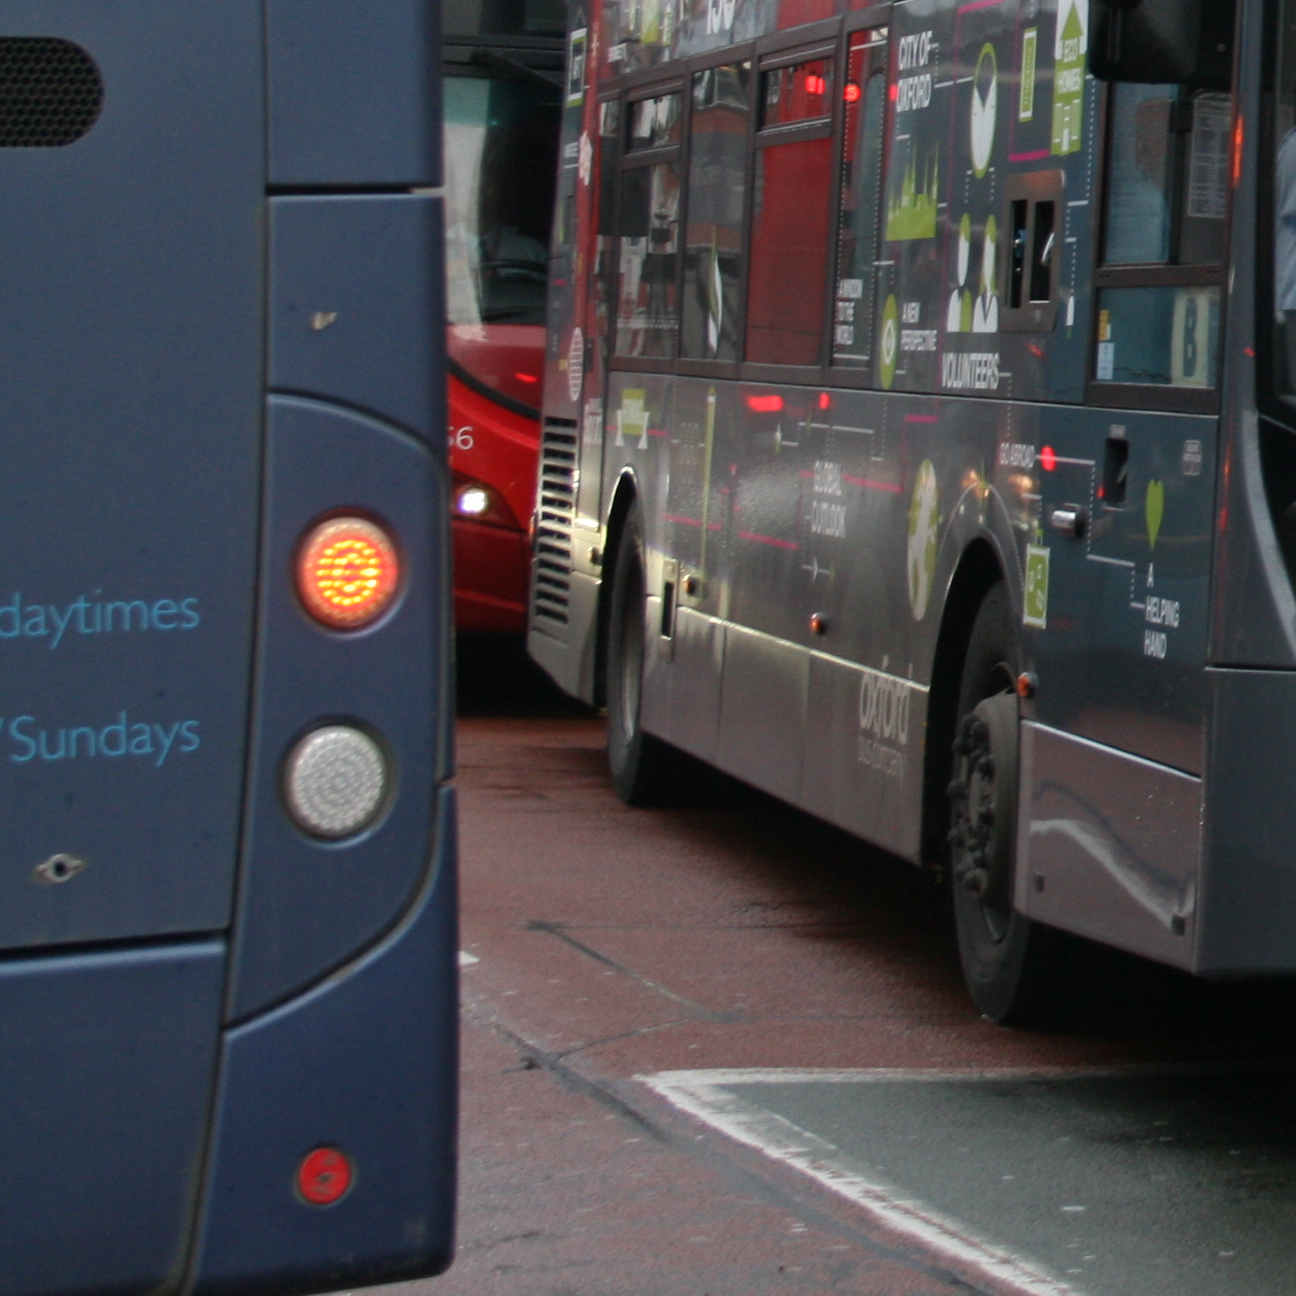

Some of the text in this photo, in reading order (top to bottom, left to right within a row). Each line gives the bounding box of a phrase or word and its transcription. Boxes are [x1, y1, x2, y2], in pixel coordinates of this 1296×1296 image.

[899, 30, 933, 71] CITY OF
[897, 73, 932, 112] OXFORD
[942, 352, 1000, 390] VOLUNTEERS
[1010, 443, 1036, 469] ABROAD
[1145, 563, 1155, 589] A
[0, 588, 201, 650] daytimes
[1144, 596, 1180, 629] HELPING
[1143, 629, 1167, 661] HAND
